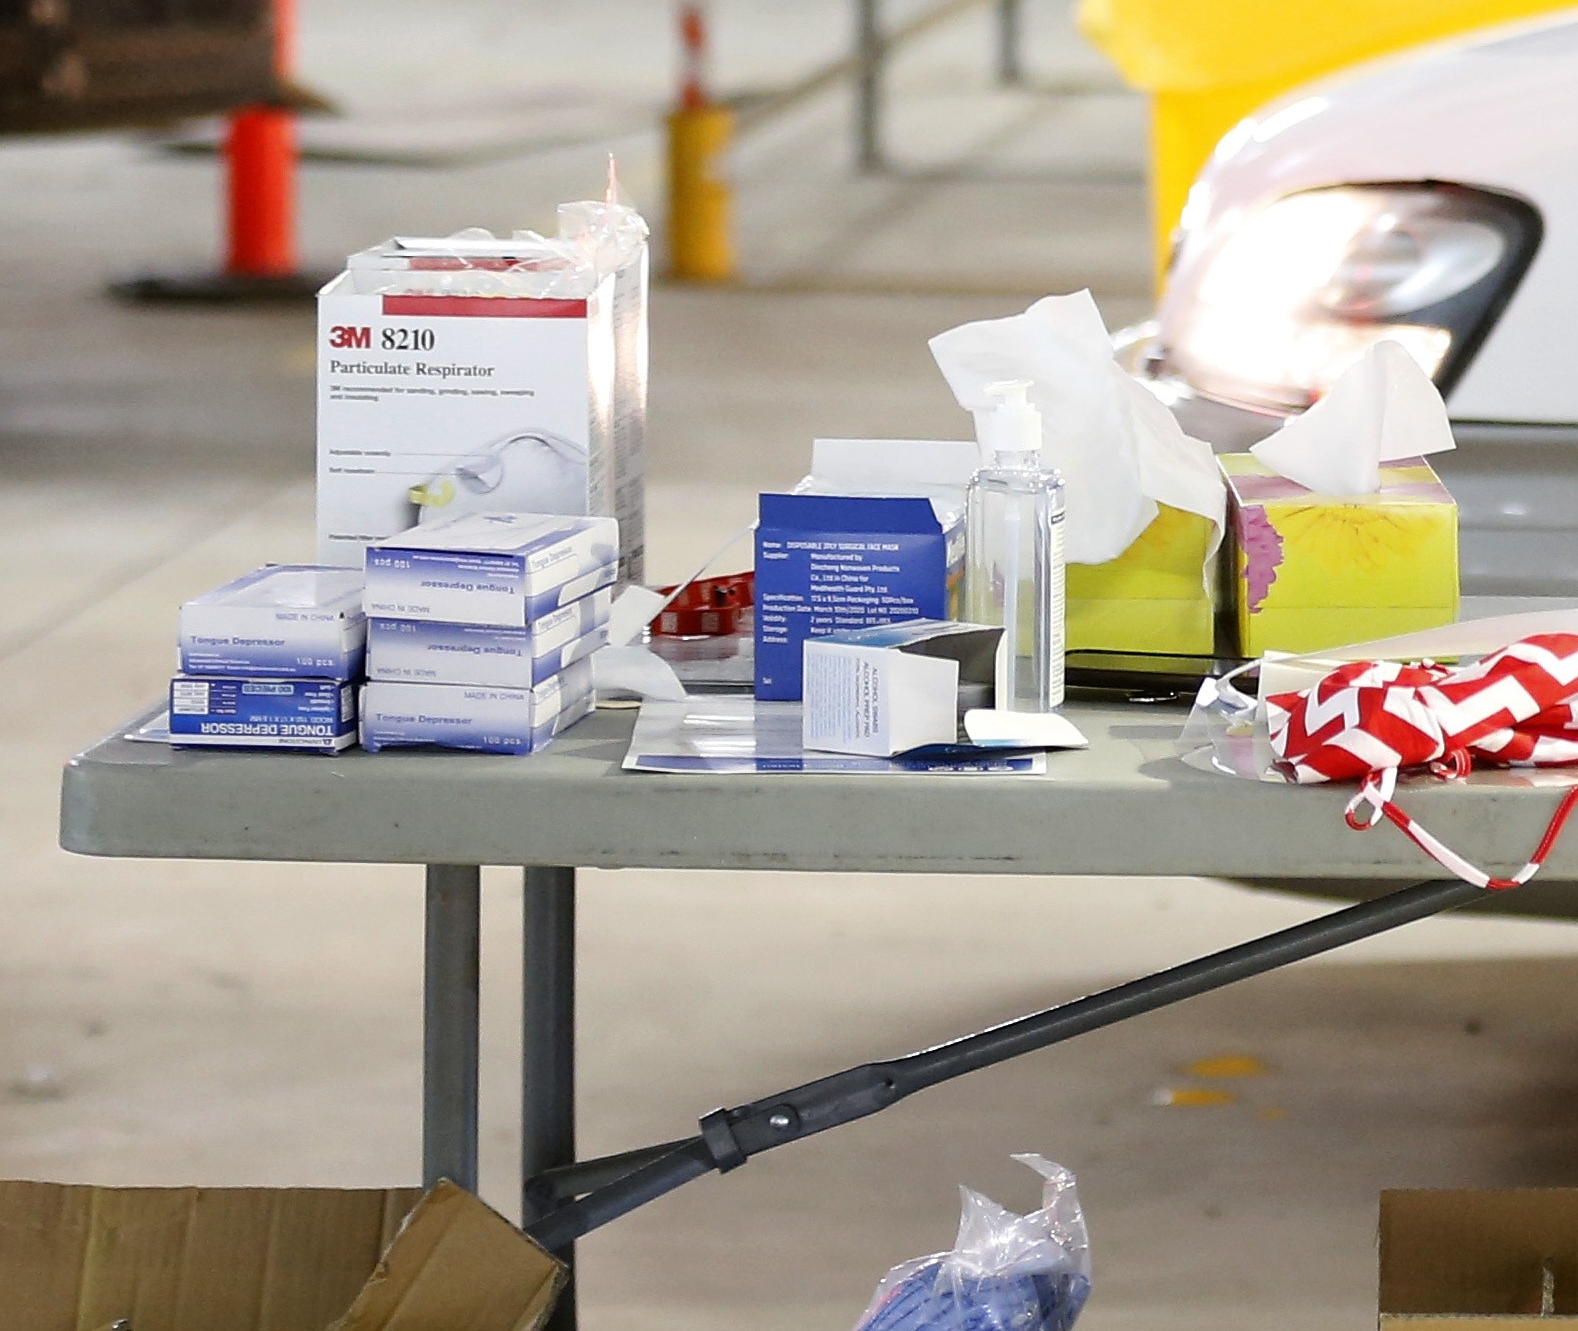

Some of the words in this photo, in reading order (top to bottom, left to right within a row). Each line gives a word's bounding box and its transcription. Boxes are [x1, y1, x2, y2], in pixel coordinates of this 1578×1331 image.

[329, 326, 371, 349] 3M
[381, 328, 435, 351] 8210
[330, 360, 411, 376] Particulate
[415, 363, 495, 379] Respirator
[882, 543, 900, 551] MASK
[810, 553, 855, 561] Manufactured
[872, 565, 900, 573] Products
[421, 580, 474, 592] Depressor
[476, 583, 515, 595] Tongue
[190, 635, 230, 647] Tongue
[232, 636, 286, 648] Depressor
[426, 644, 481, 656] Depressor
[483, 646, 523, 658] Tongue
[376, 713, 415, 724] Tongue
[418, 714, 473, 726] Depressor
[201, 723, 278, 736] DEPRESSOR
[282, 724, 335, 737] TONGUE
